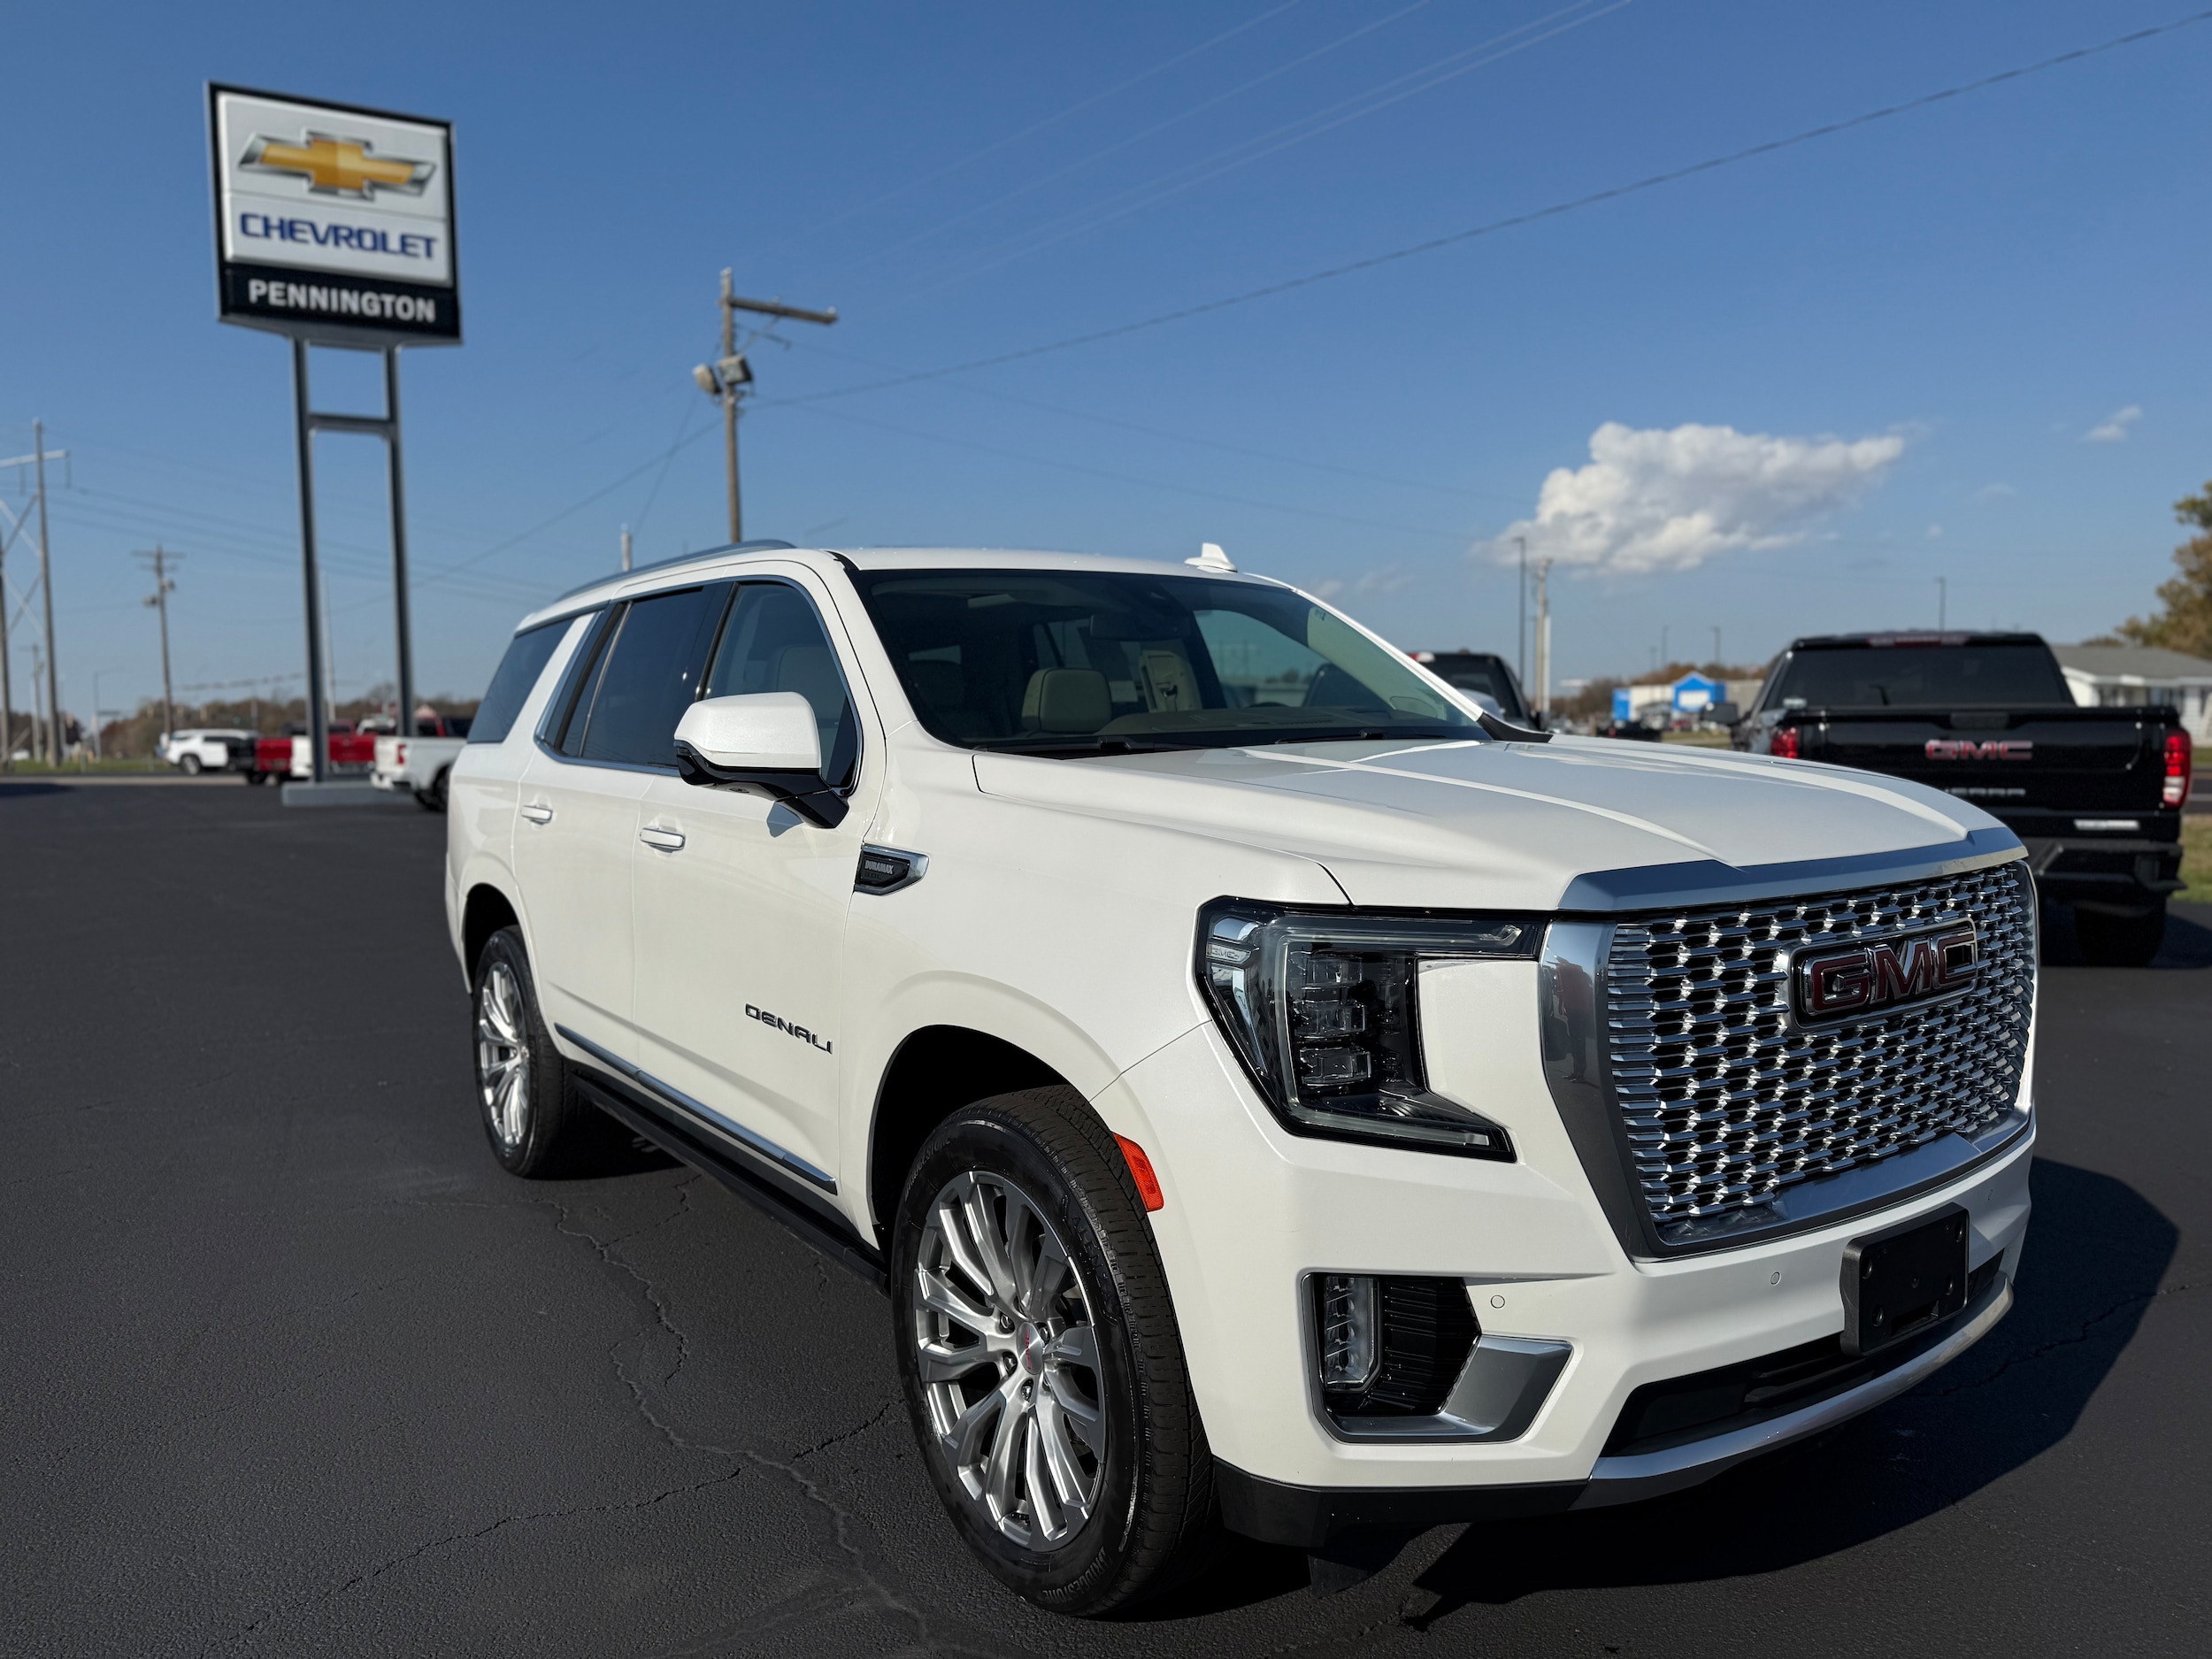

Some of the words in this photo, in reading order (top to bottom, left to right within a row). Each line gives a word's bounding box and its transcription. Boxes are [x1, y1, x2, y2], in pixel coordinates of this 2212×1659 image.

[239, 212, 437, 259] CHEVROLET
[249, 279, 436, 323] PENNINGTON
[1925, 740, 2033, 760] GMC
[864, 859, 894, 875] DURAMAX
[1802, 930, 1977, 1016] GMC
[745, 1002, 833, 1055] DENALI
[1041, 1546, 1113, 1604] BRIDGESTONE
